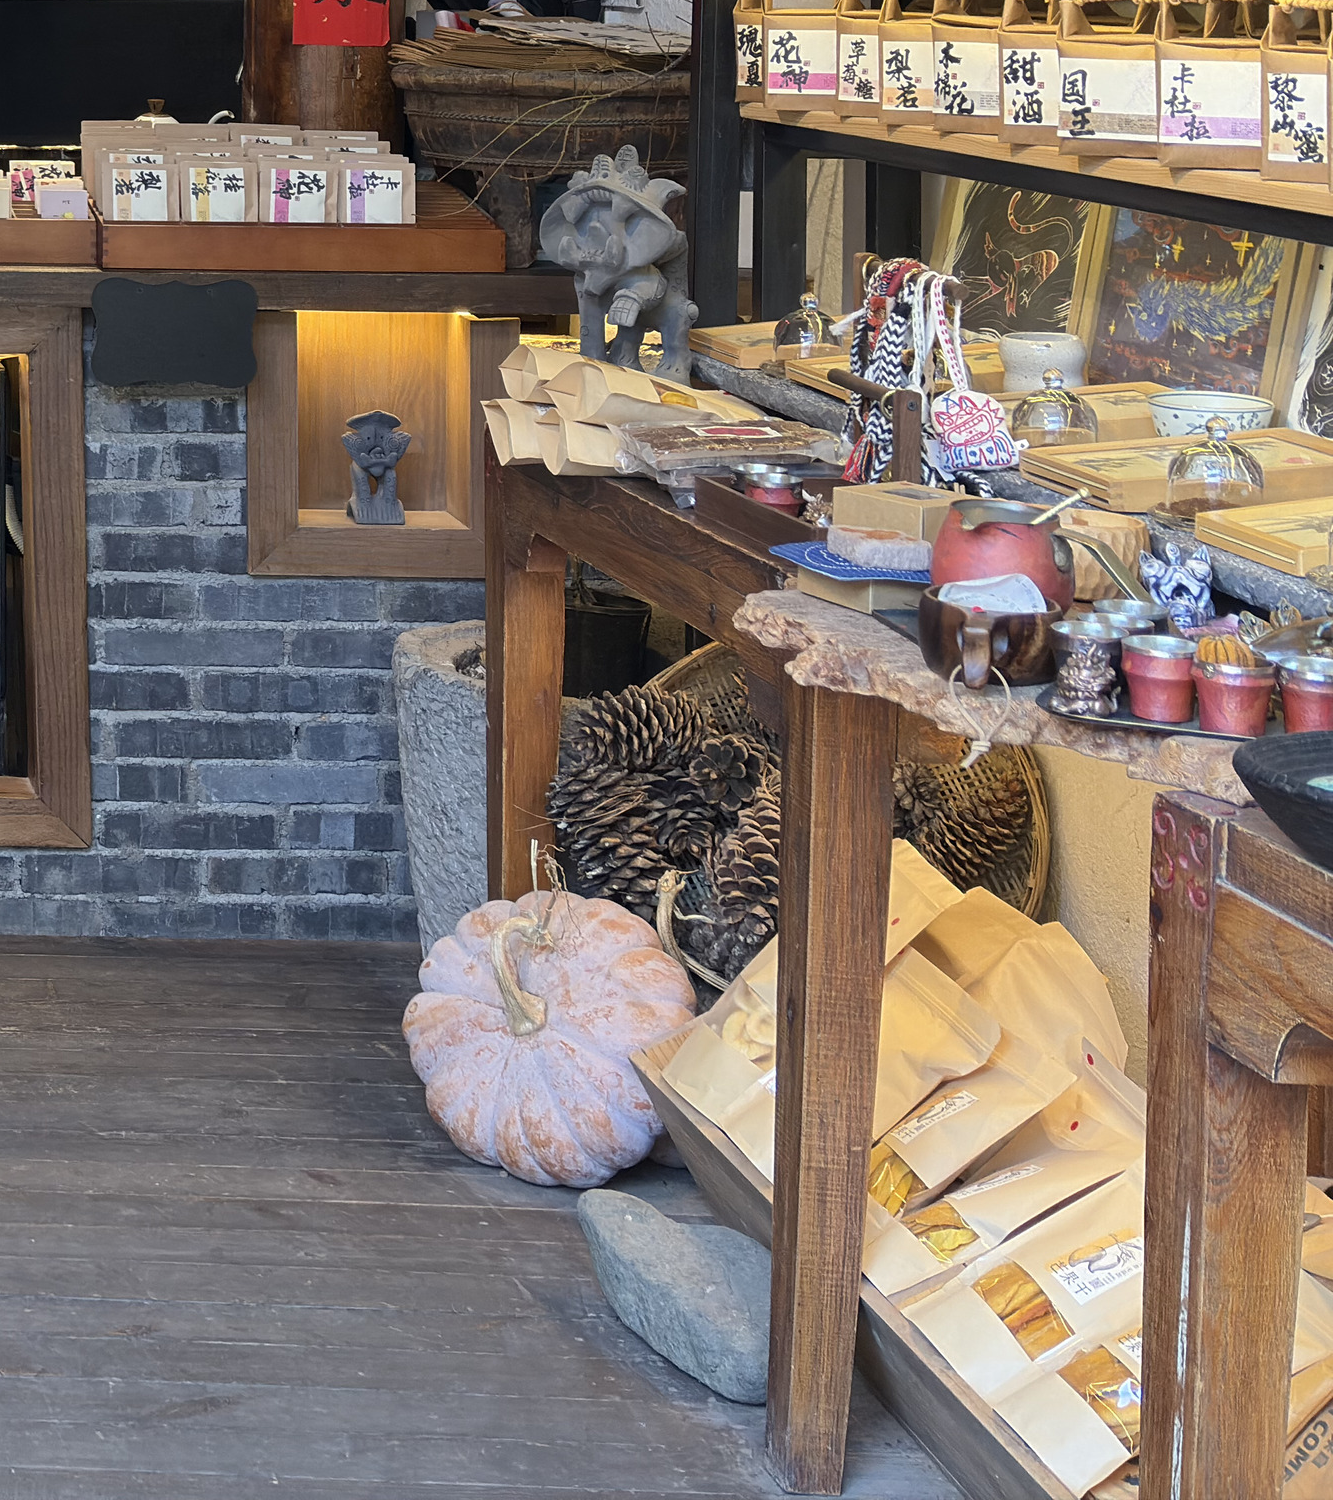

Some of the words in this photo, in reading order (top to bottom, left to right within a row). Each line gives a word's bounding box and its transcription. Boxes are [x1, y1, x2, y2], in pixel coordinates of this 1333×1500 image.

[770, 31, 810, 93] 花神
[1003, 50, 1043, 124] 甜酒
[1061, 69, 1096, 137] 国王
[1049, 1260, 1092, 1296] 芒果干
